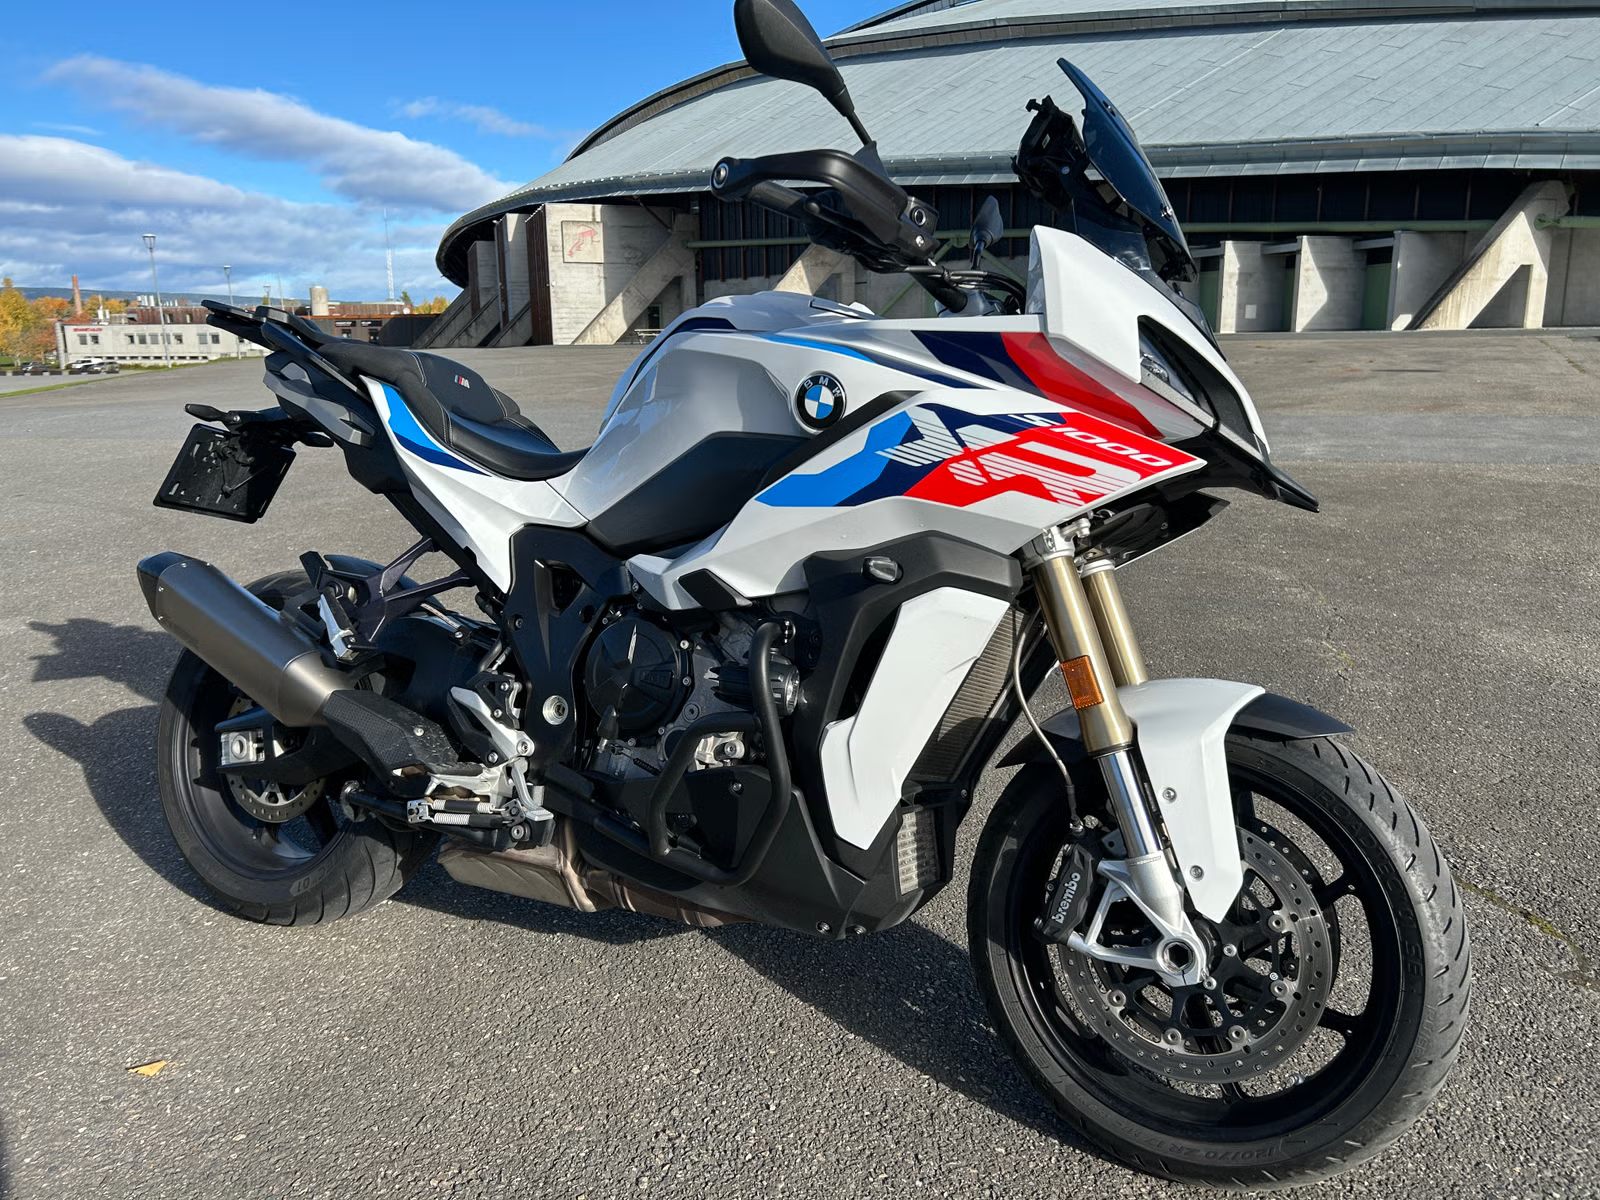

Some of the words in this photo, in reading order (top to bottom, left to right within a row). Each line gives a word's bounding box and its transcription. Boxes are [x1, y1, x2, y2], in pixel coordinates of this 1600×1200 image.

[803, 375, 842, 398] BMW
[1049, 427, 1174, 467] 1000
[1051, 872, 1081, 924] brembo
